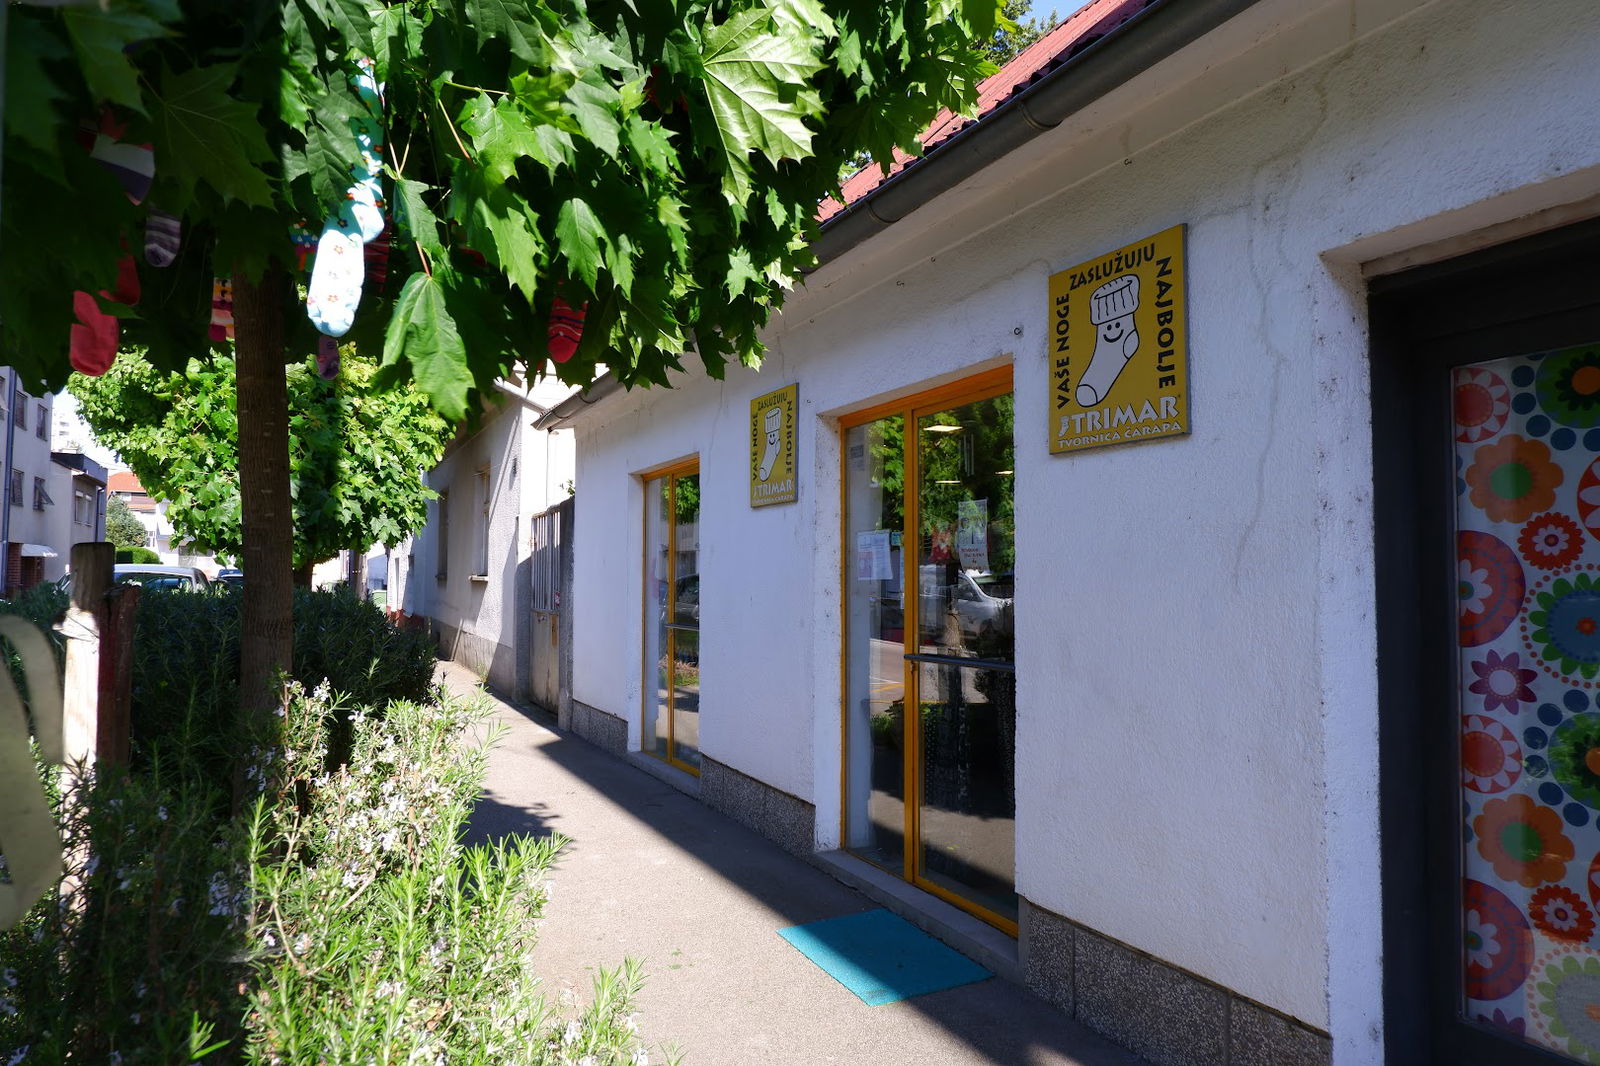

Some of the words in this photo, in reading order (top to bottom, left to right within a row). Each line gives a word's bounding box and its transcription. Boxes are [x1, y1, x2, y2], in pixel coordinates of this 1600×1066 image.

[1069, 243, 1155, 290] ZASLUŽUJU
[1056, 293, 1070, 352] NOGE
[1155, 256, 1175, 389] NAJBOLJE
[1054, 357, 1071, 410] VAŠE
[1059, 431, 1121, 449] TVORNICA
[1124, 421, 1181, 438] ČARAPA
